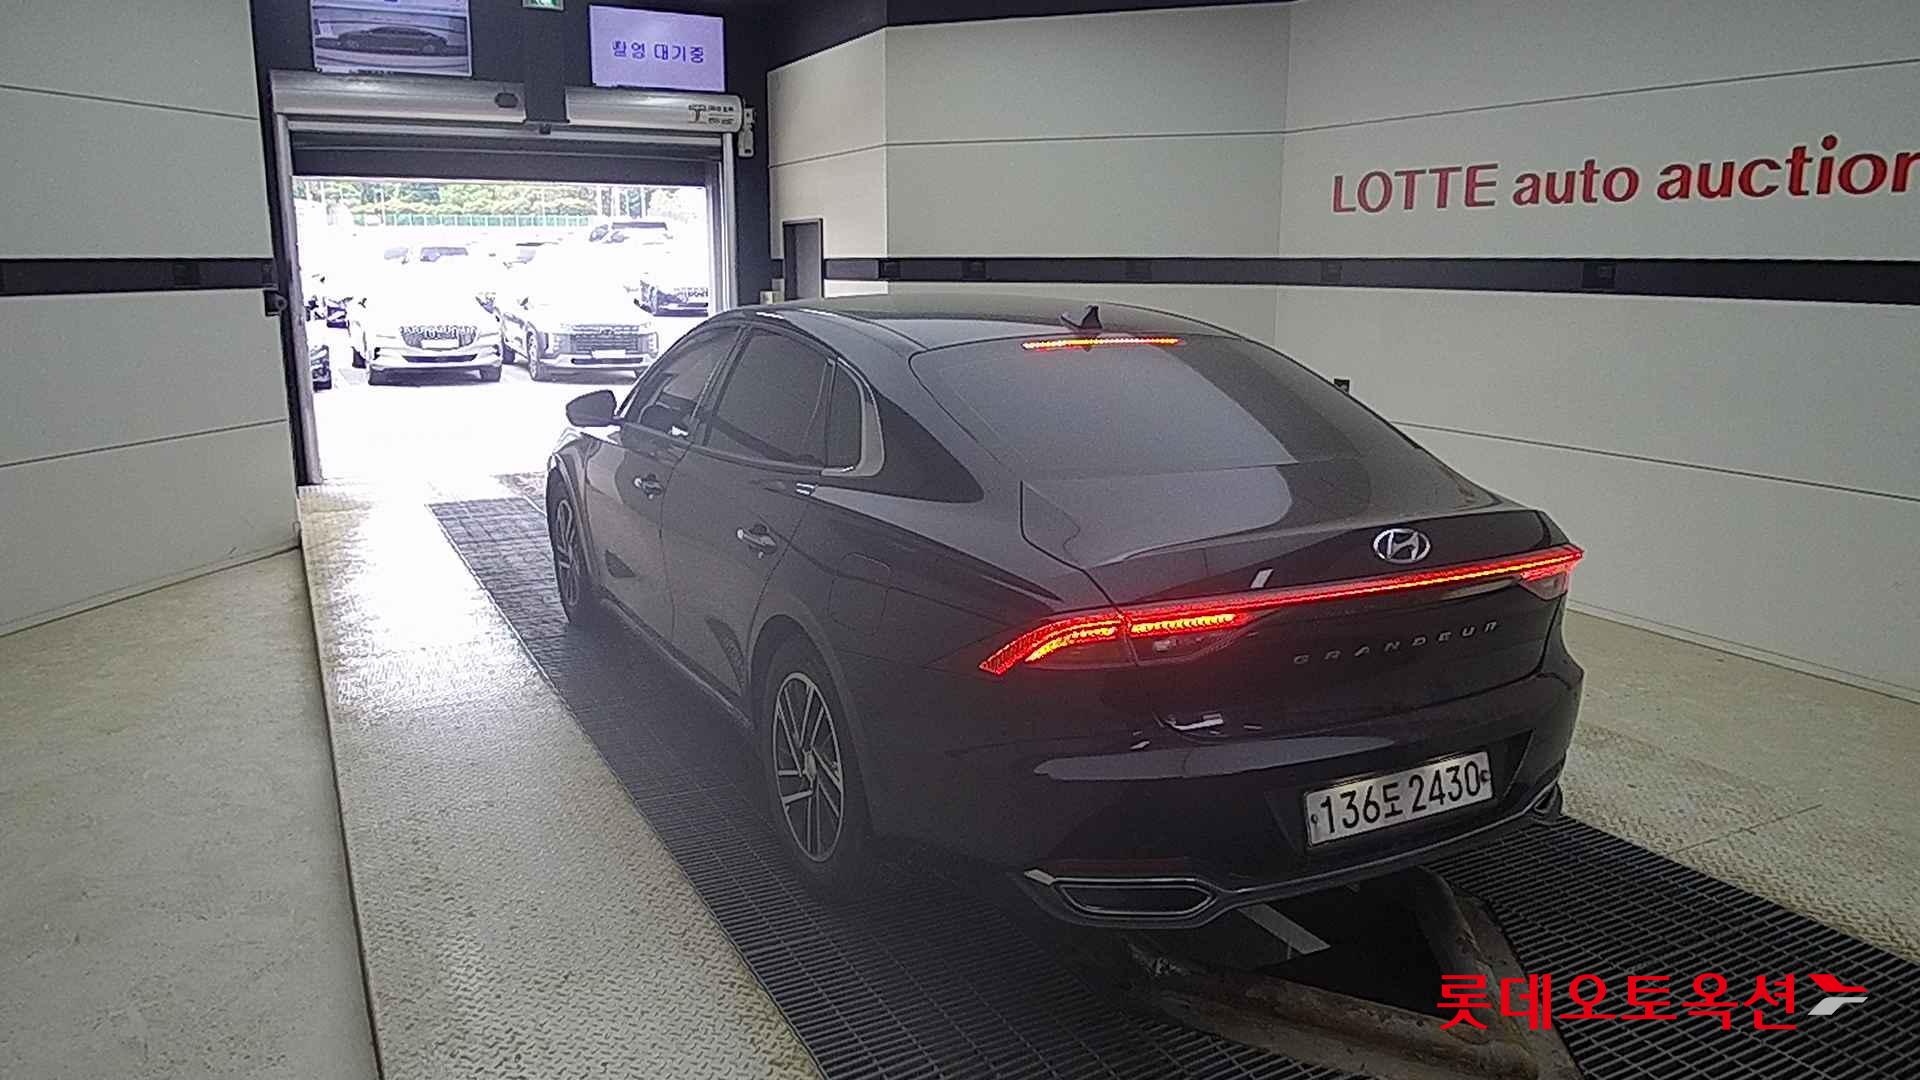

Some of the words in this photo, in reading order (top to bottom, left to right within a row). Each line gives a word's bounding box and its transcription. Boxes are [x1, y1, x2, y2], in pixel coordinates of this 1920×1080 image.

[654, 43, 704, 63] 대기중
[1332, 163, 1499, 213] LOTTE
[1512, 159, 1639, 206] auto
[1294, 620, 1497, 664] GRANDEUR
[1408, 760, 1482, 813] 2430
